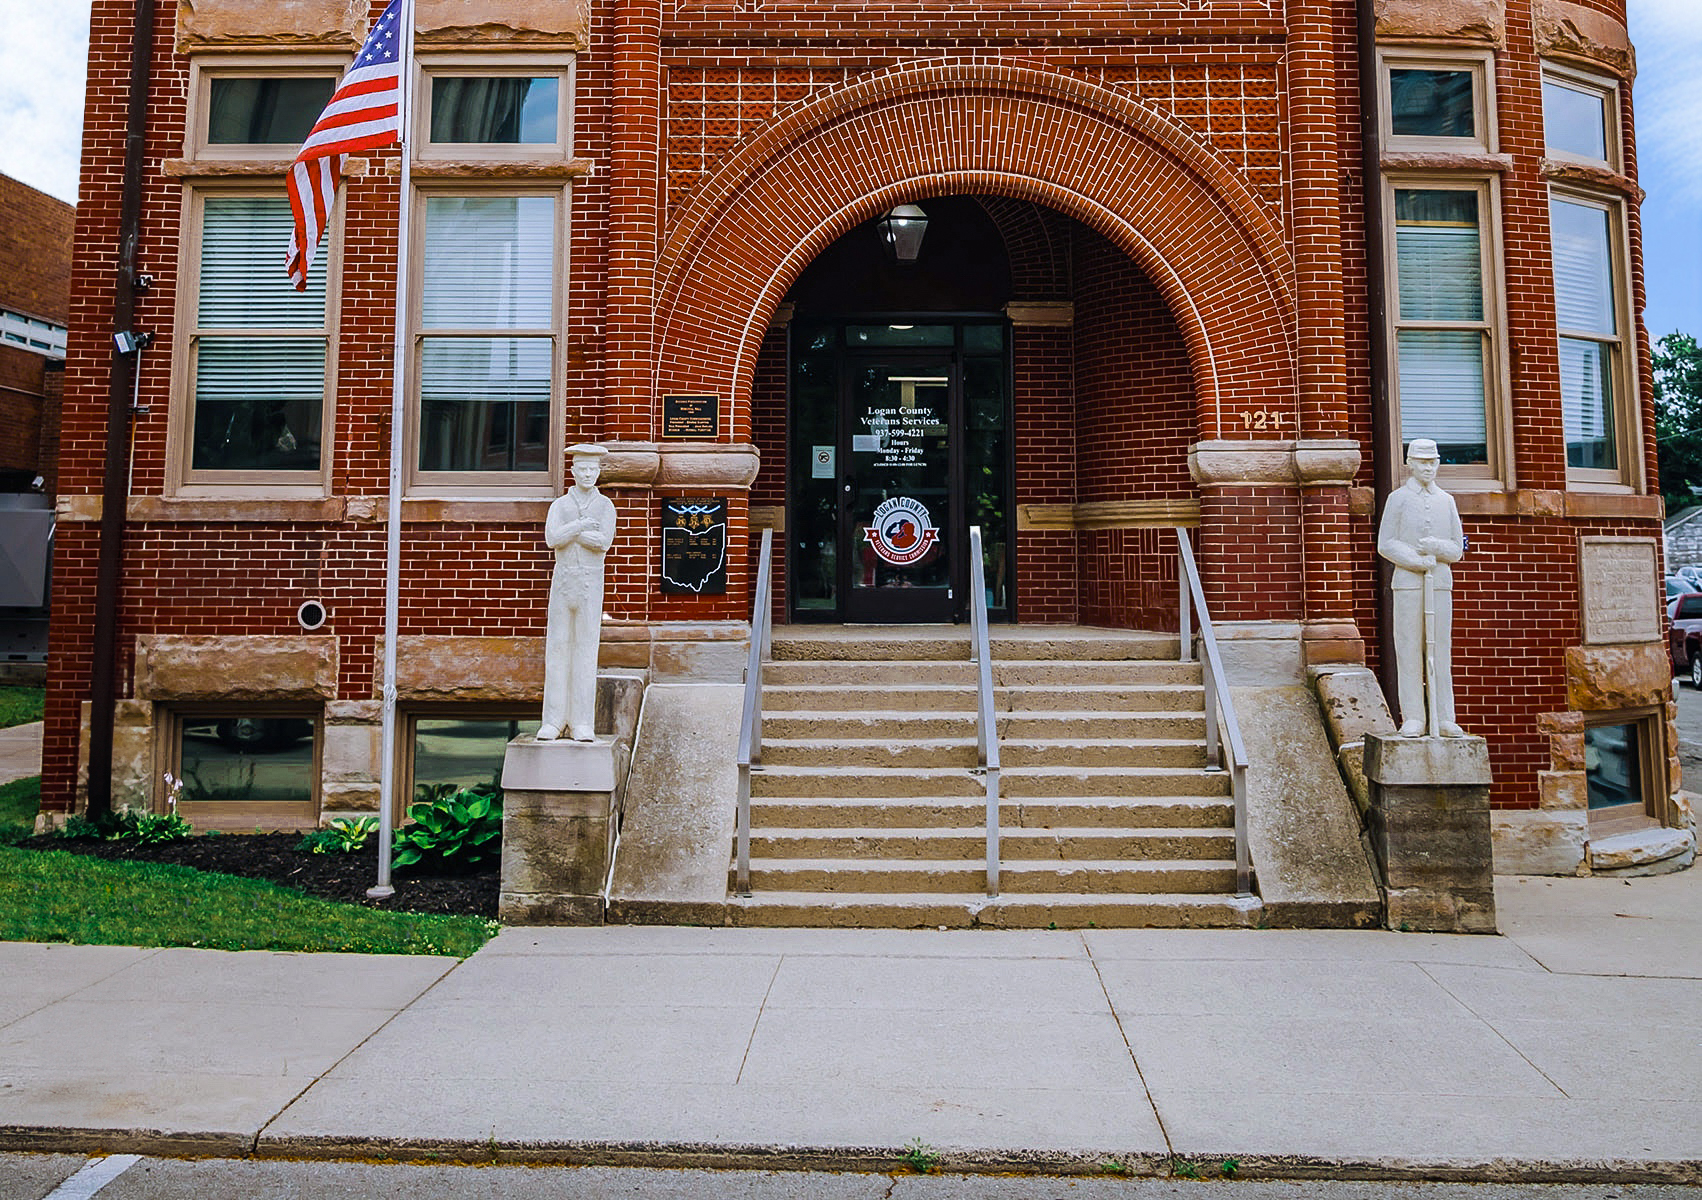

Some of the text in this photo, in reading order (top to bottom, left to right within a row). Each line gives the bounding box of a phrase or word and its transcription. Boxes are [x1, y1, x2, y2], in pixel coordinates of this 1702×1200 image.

[867, 406, 933, 417] Logan County
[860, 417, 940, 426] Veterans Services
[1240, 410, 1280, 430] 121
[875, 428, 924, 438] 937-599-4221
[904, 447, 924, 455] Friday
[875, 498, 929, 517] LOGAN COUNTY
